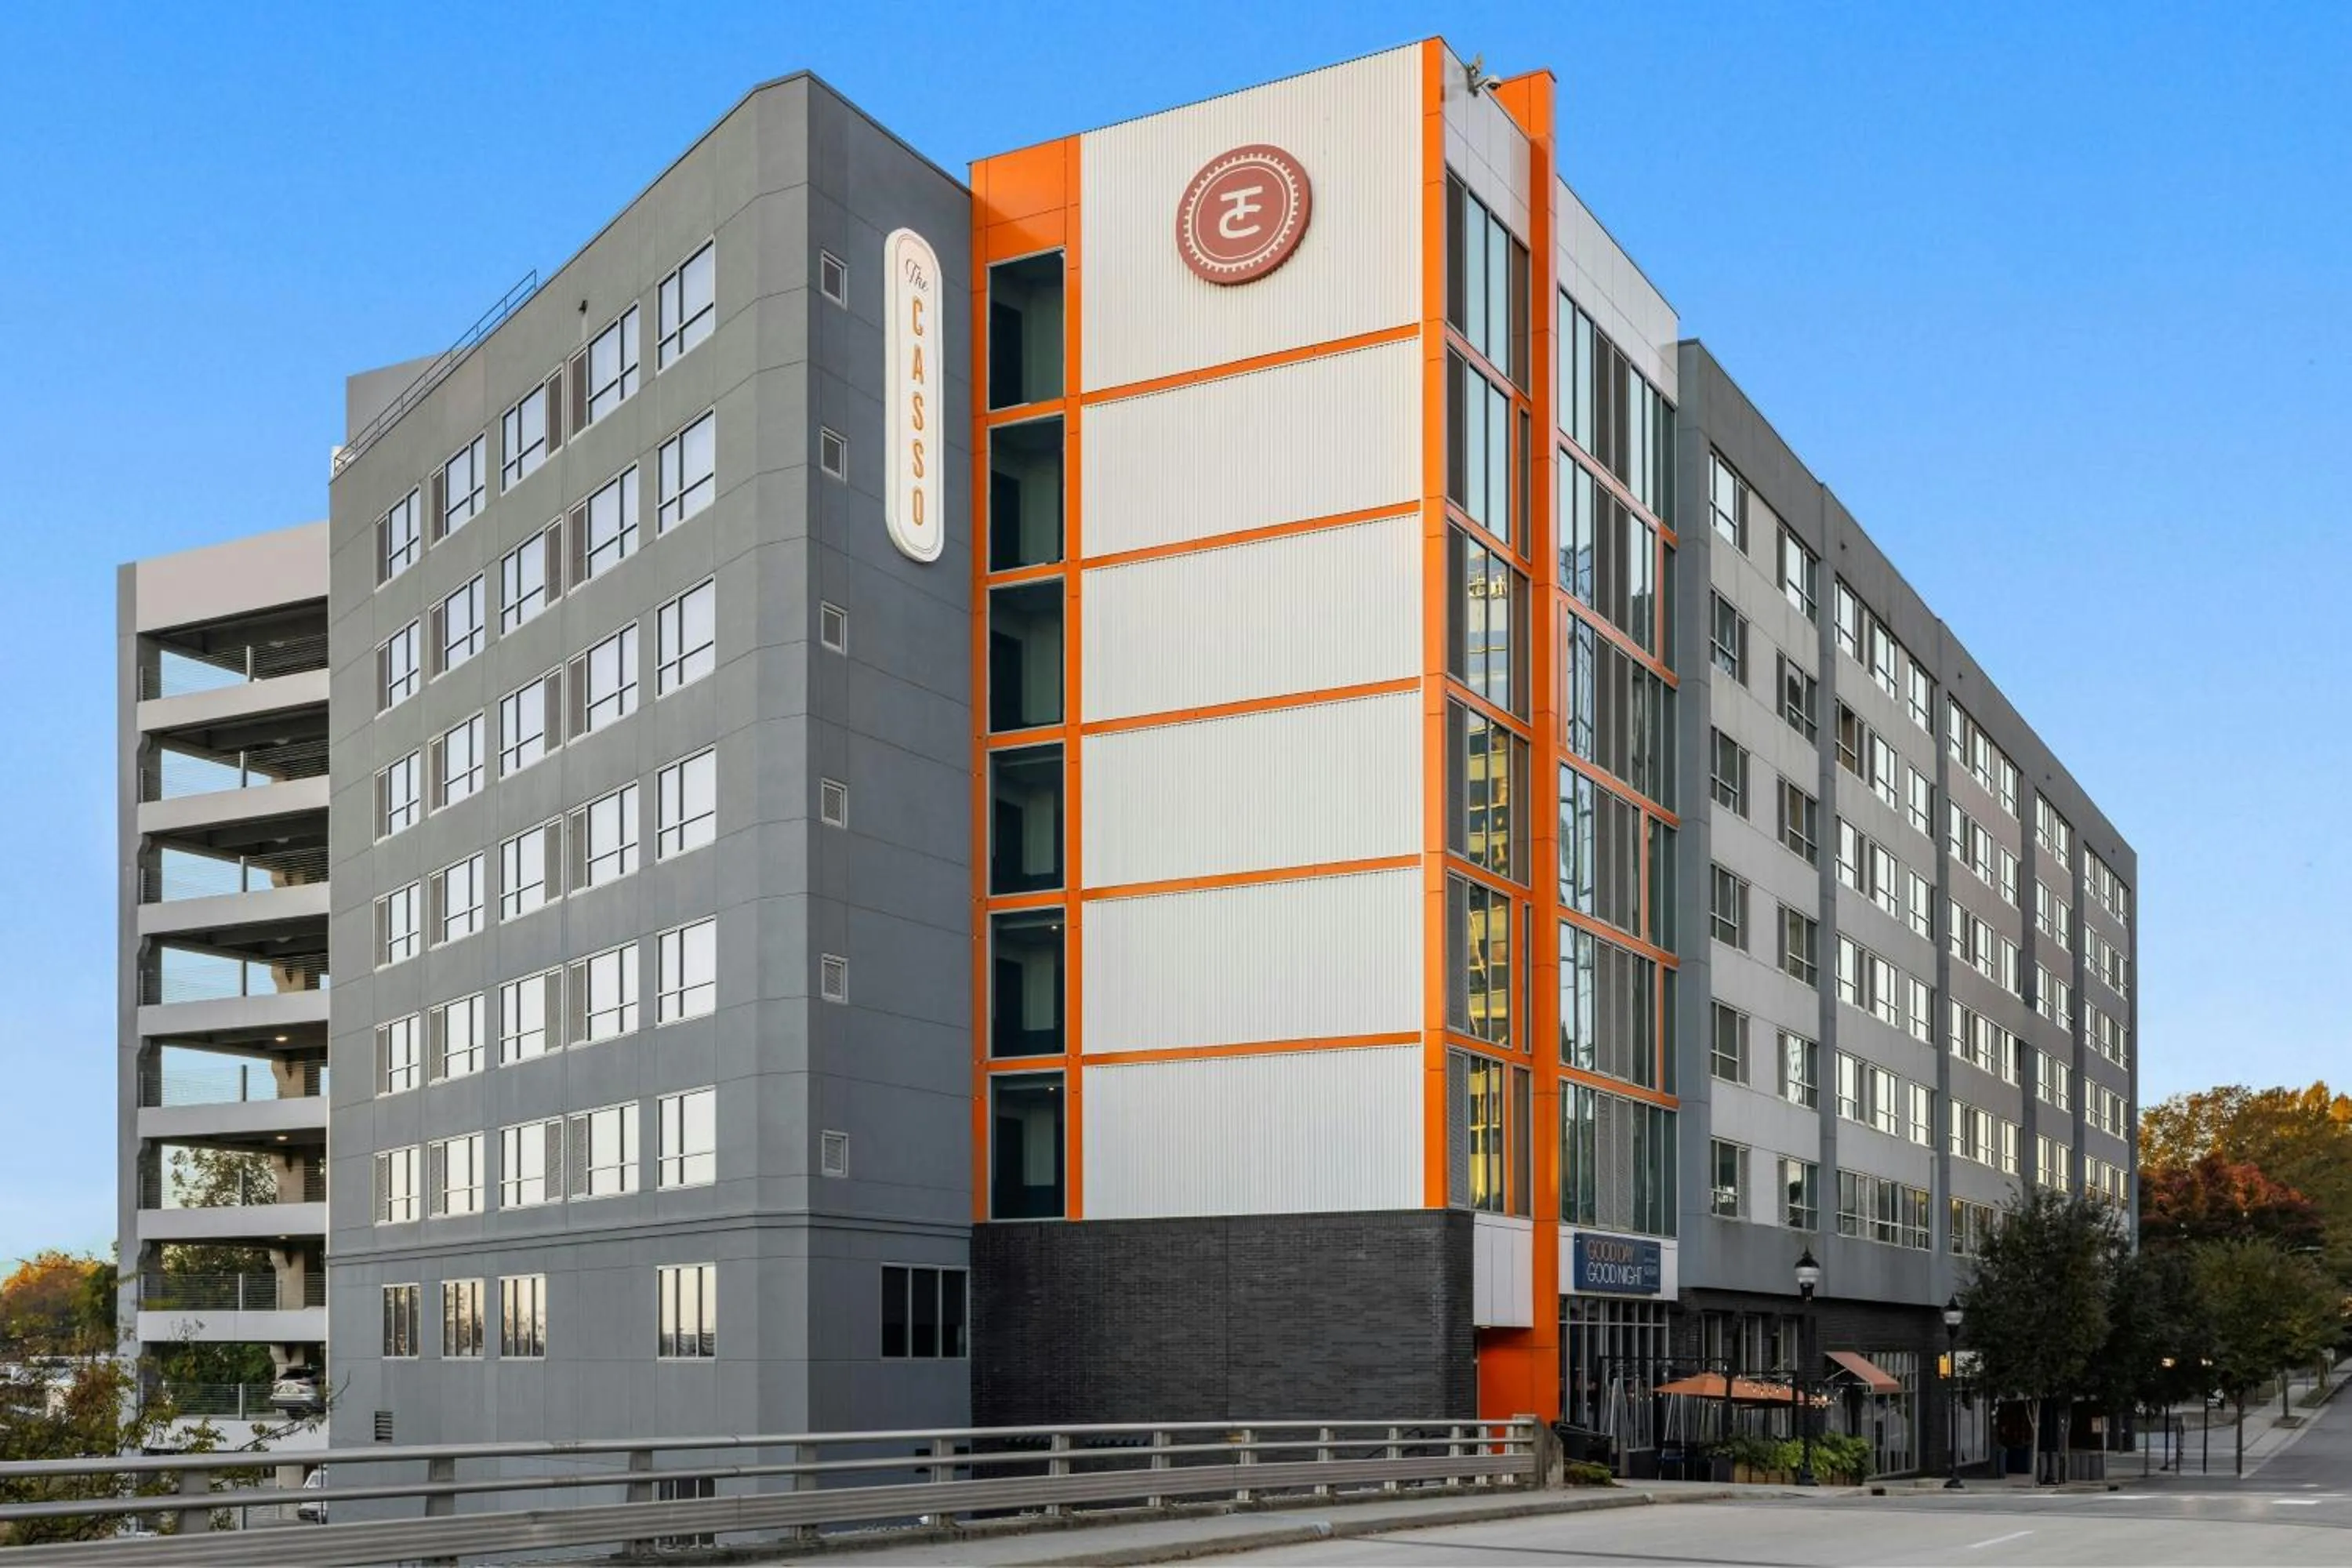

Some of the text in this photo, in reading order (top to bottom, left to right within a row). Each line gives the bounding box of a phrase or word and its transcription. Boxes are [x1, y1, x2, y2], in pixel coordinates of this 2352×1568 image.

[905, 258, 929, 292] The
[910, 295, 924, 527] CASSO
[1586, 1240, 1617, 1261] GOOD
[1585, 1261, 1617, 1284] GOOD
[1617, 1264, 1642, 1286] NIGHT
